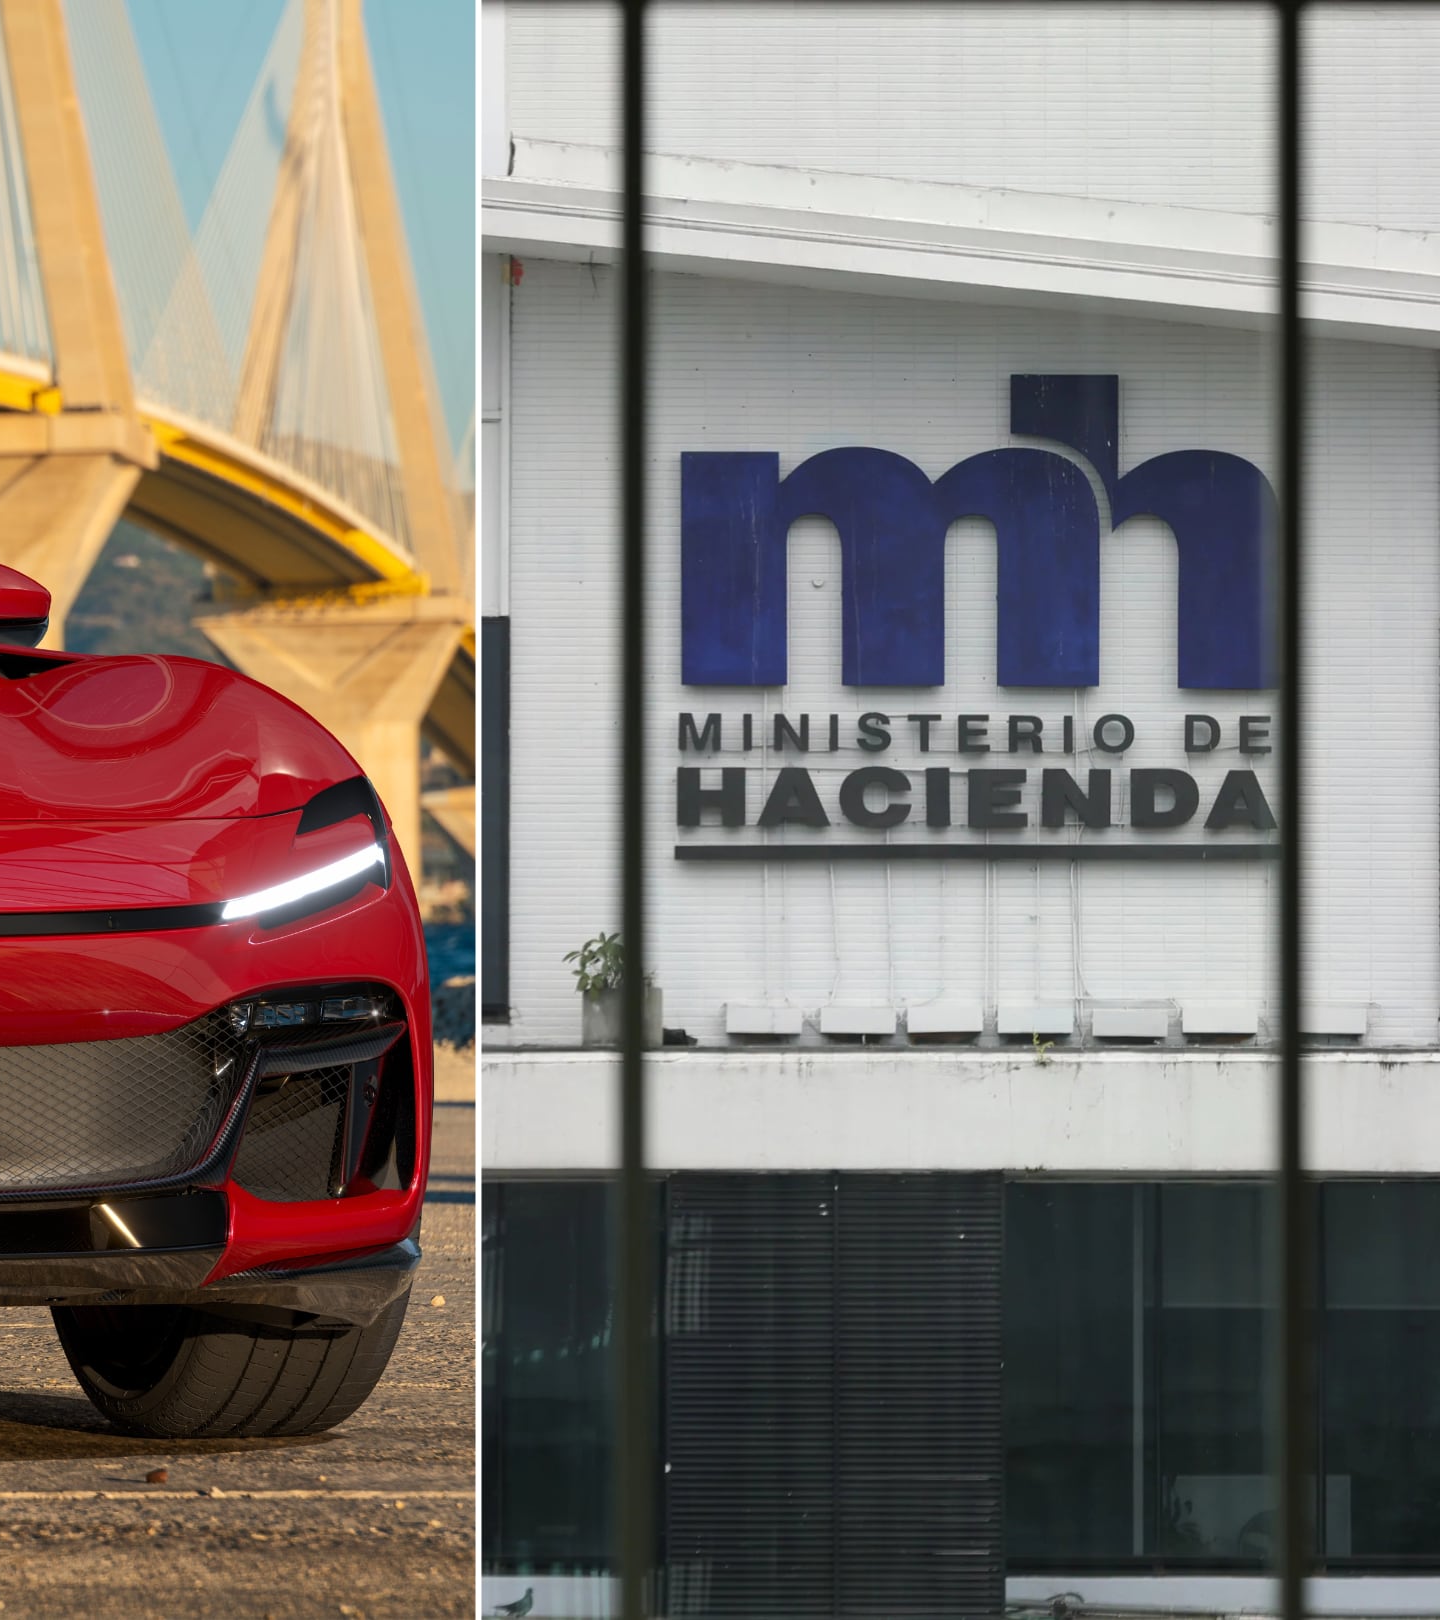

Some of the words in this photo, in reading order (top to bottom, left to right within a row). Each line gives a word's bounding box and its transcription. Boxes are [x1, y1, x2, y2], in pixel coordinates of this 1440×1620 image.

[681, 374, 1279, 689] mh
[679, 713, 1135, 753] MINISTERIO
[1184, 715, 1272, 754] DE
[677, 767, 1278, 829] HACIENDA
